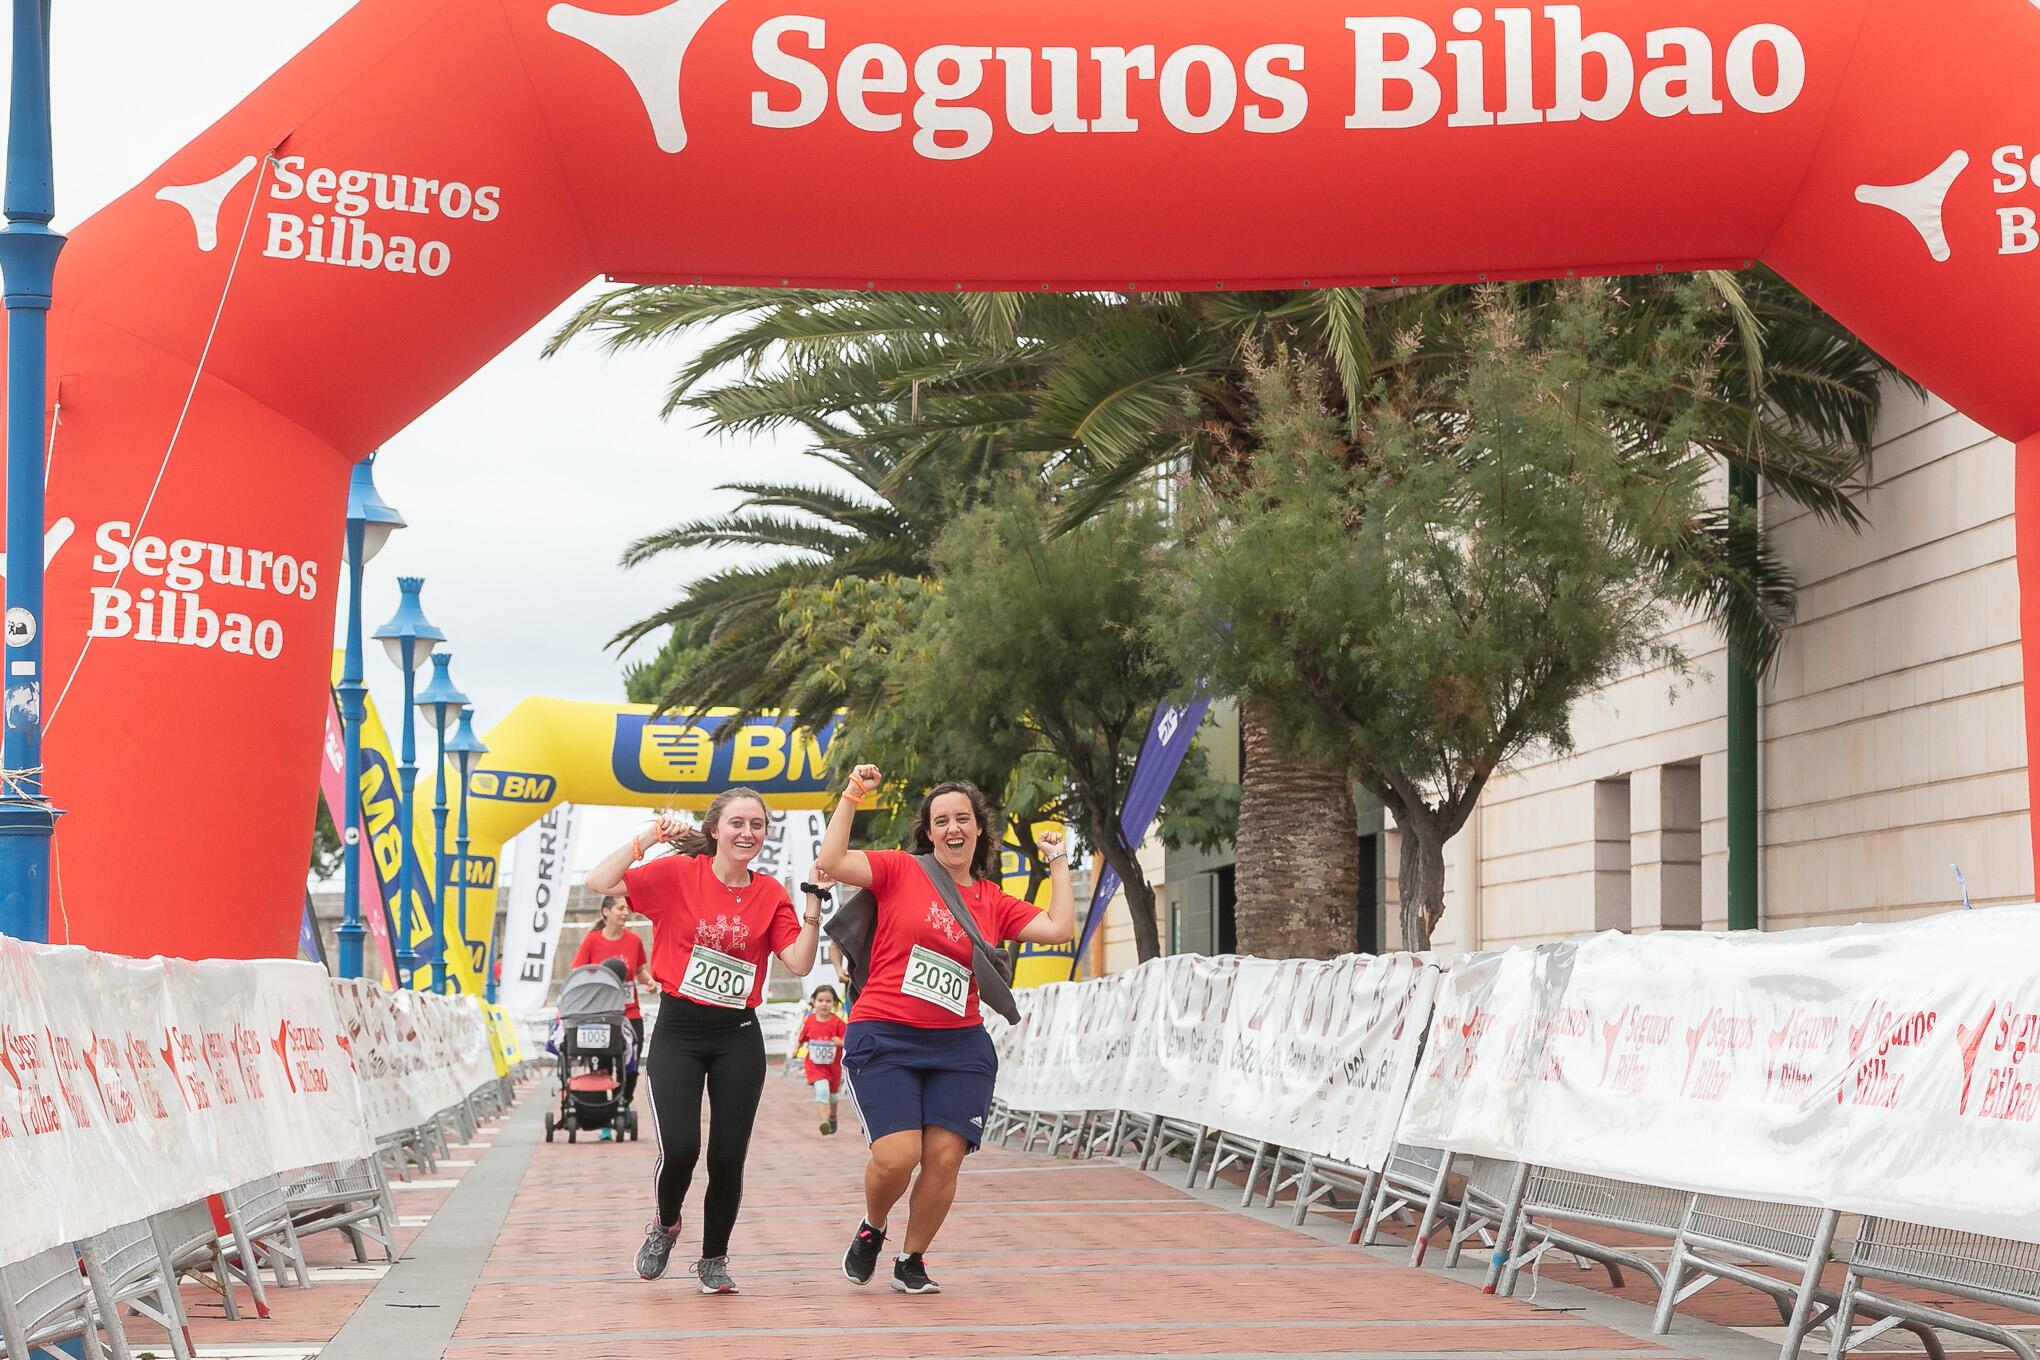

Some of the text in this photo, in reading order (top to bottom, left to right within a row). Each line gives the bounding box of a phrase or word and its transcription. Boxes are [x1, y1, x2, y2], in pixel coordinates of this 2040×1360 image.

[751, 4, 1806, 160] Seguros Bilbao
[270, 154, 500, 222] Seguros
[262, 212, 452, 278] Bilbao
[92, 520, 319, 602] Seguros
[87, 586, 285, 660] Bilbao
[728, 724, 840, 783] BM
[502, 775, 553, 801] BM
[450, 859, 494, 884] BM
[520, 942, 547, 982] EL
[690, 961, 745, 996] 2030
[911, 961, 962, 1001] 2030
[581, 1031, 607, 1043] 1005
